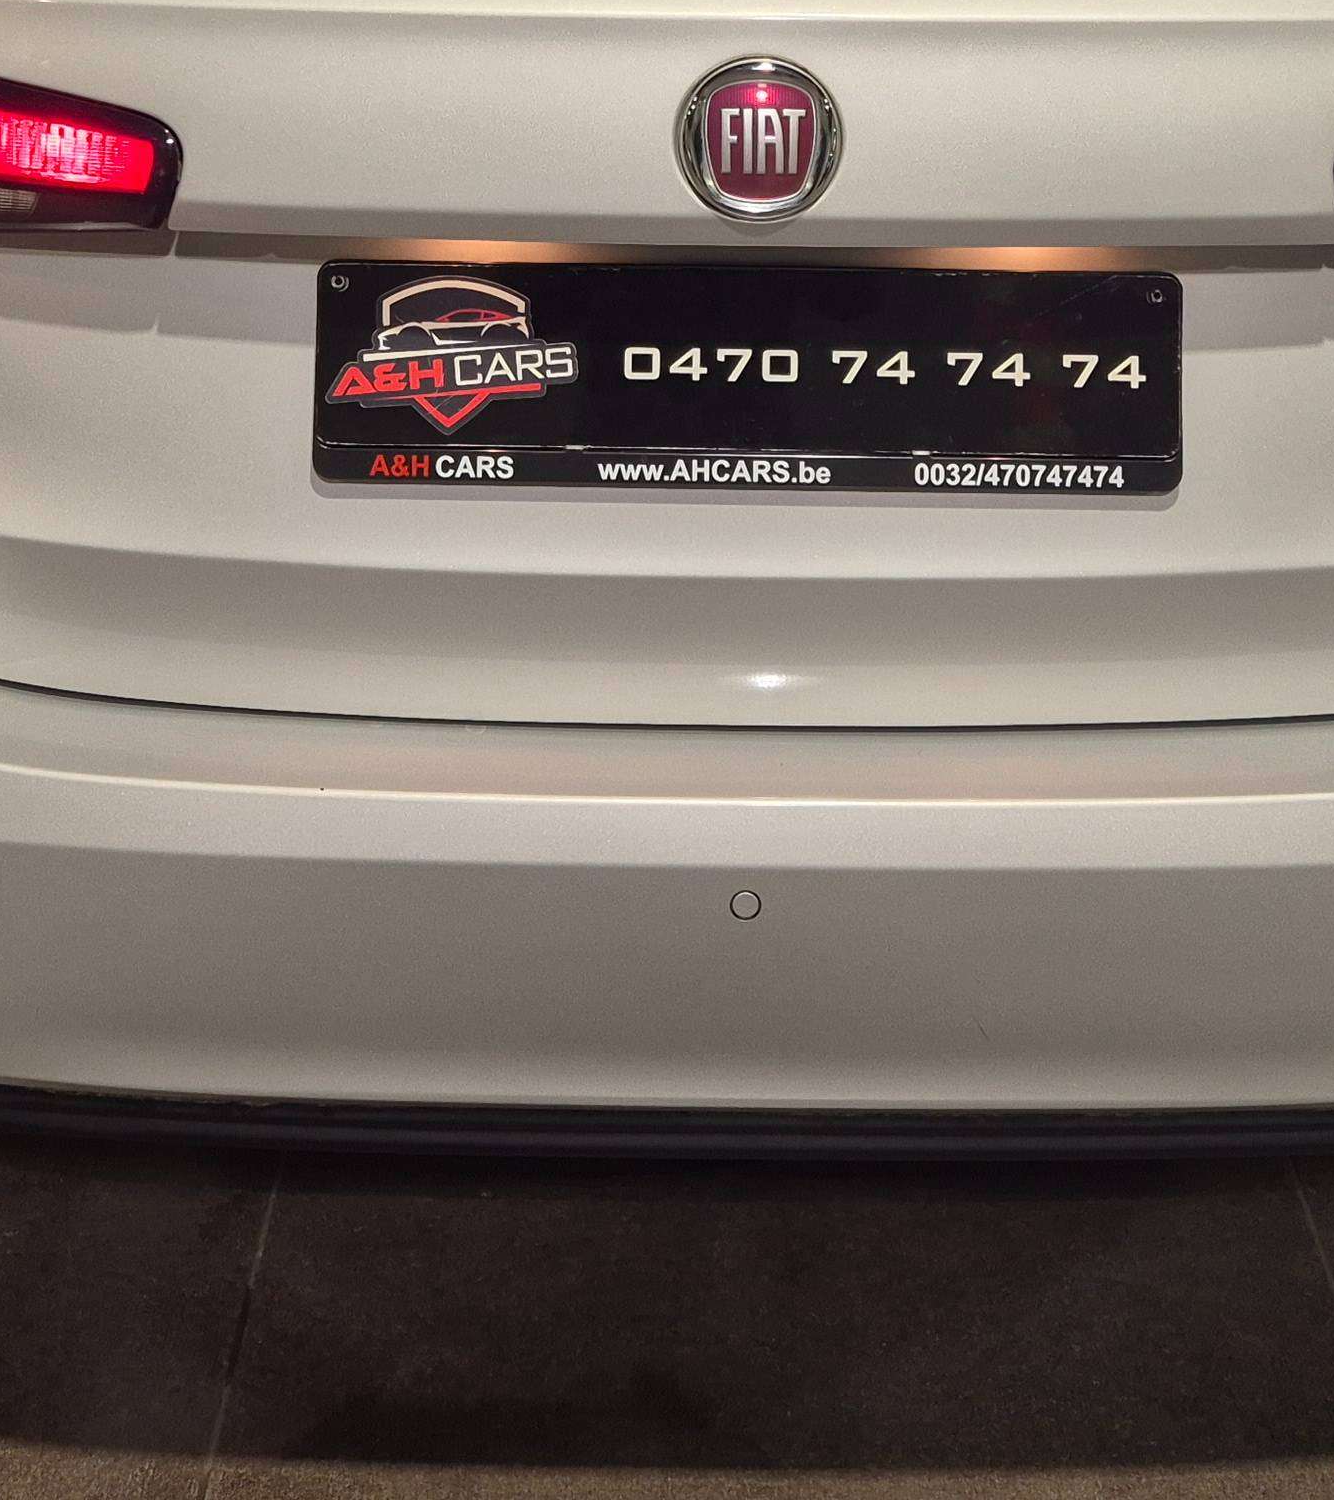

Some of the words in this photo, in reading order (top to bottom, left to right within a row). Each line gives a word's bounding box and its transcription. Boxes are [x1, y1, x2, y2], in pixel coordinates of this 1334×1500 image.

[720, 107, 807, 175] FIAT
[331, 358, 446, 397] A&H
[453, 346, 574, 387] CARS
[623, 346, 799, 383] 0470
[831, 349, 916, 385] 74
[946, 351, 1031, 388] 74
[1062, 353, 1147, 390] 74
[369, 454, 430, 478] A&H
[434, 454, 515, 480] CARS
[597, 458, 833, 485] www.AHCARS.be
[913, 462, 1125, 488] 0032/470747474
